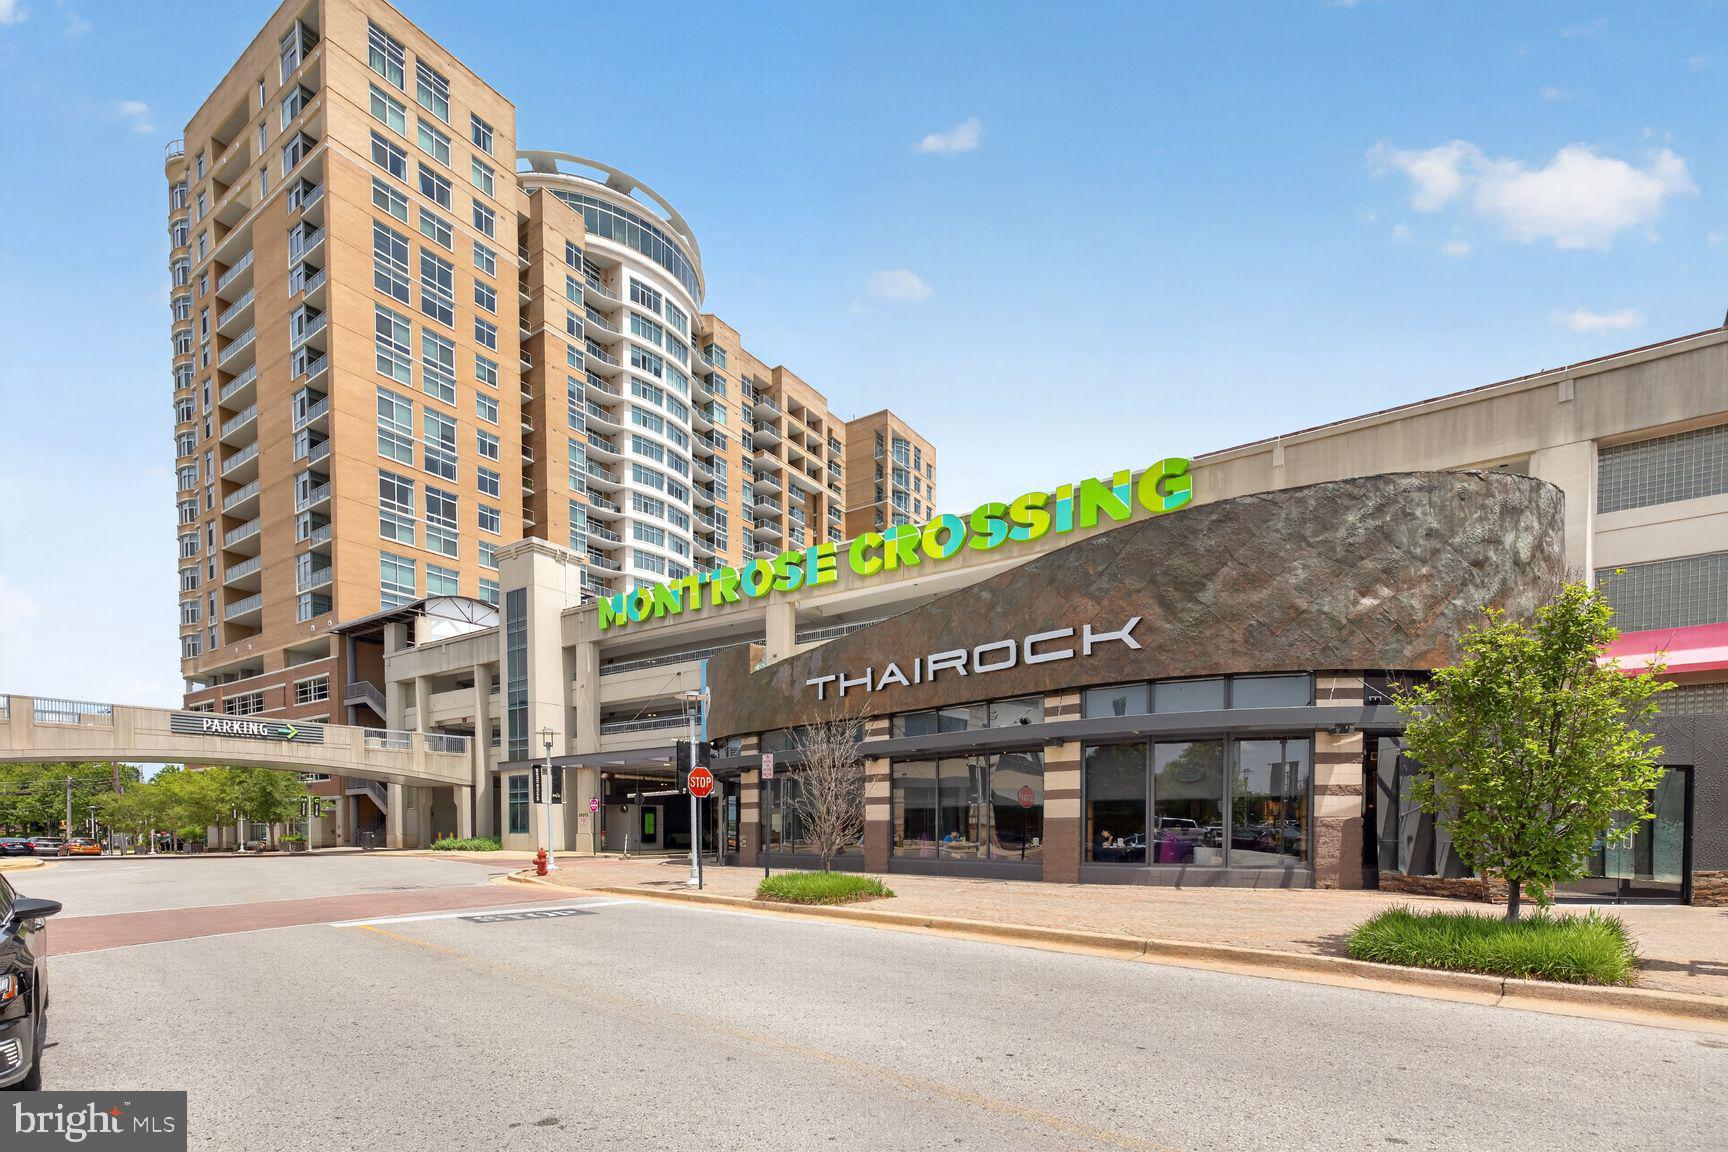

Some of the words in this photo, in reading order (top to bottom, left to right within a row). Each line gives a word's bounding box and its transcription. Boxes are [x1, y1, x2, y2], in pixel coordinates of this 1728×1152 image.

[598, 541, 839, 630] MONTROSE
[849, 457, 1194, 577] CROSSING
[806, 616, 1143, 700] THAIROCK
[203, 718, 268, 736] PARKING
[690, 776, 712, 788] STOP
